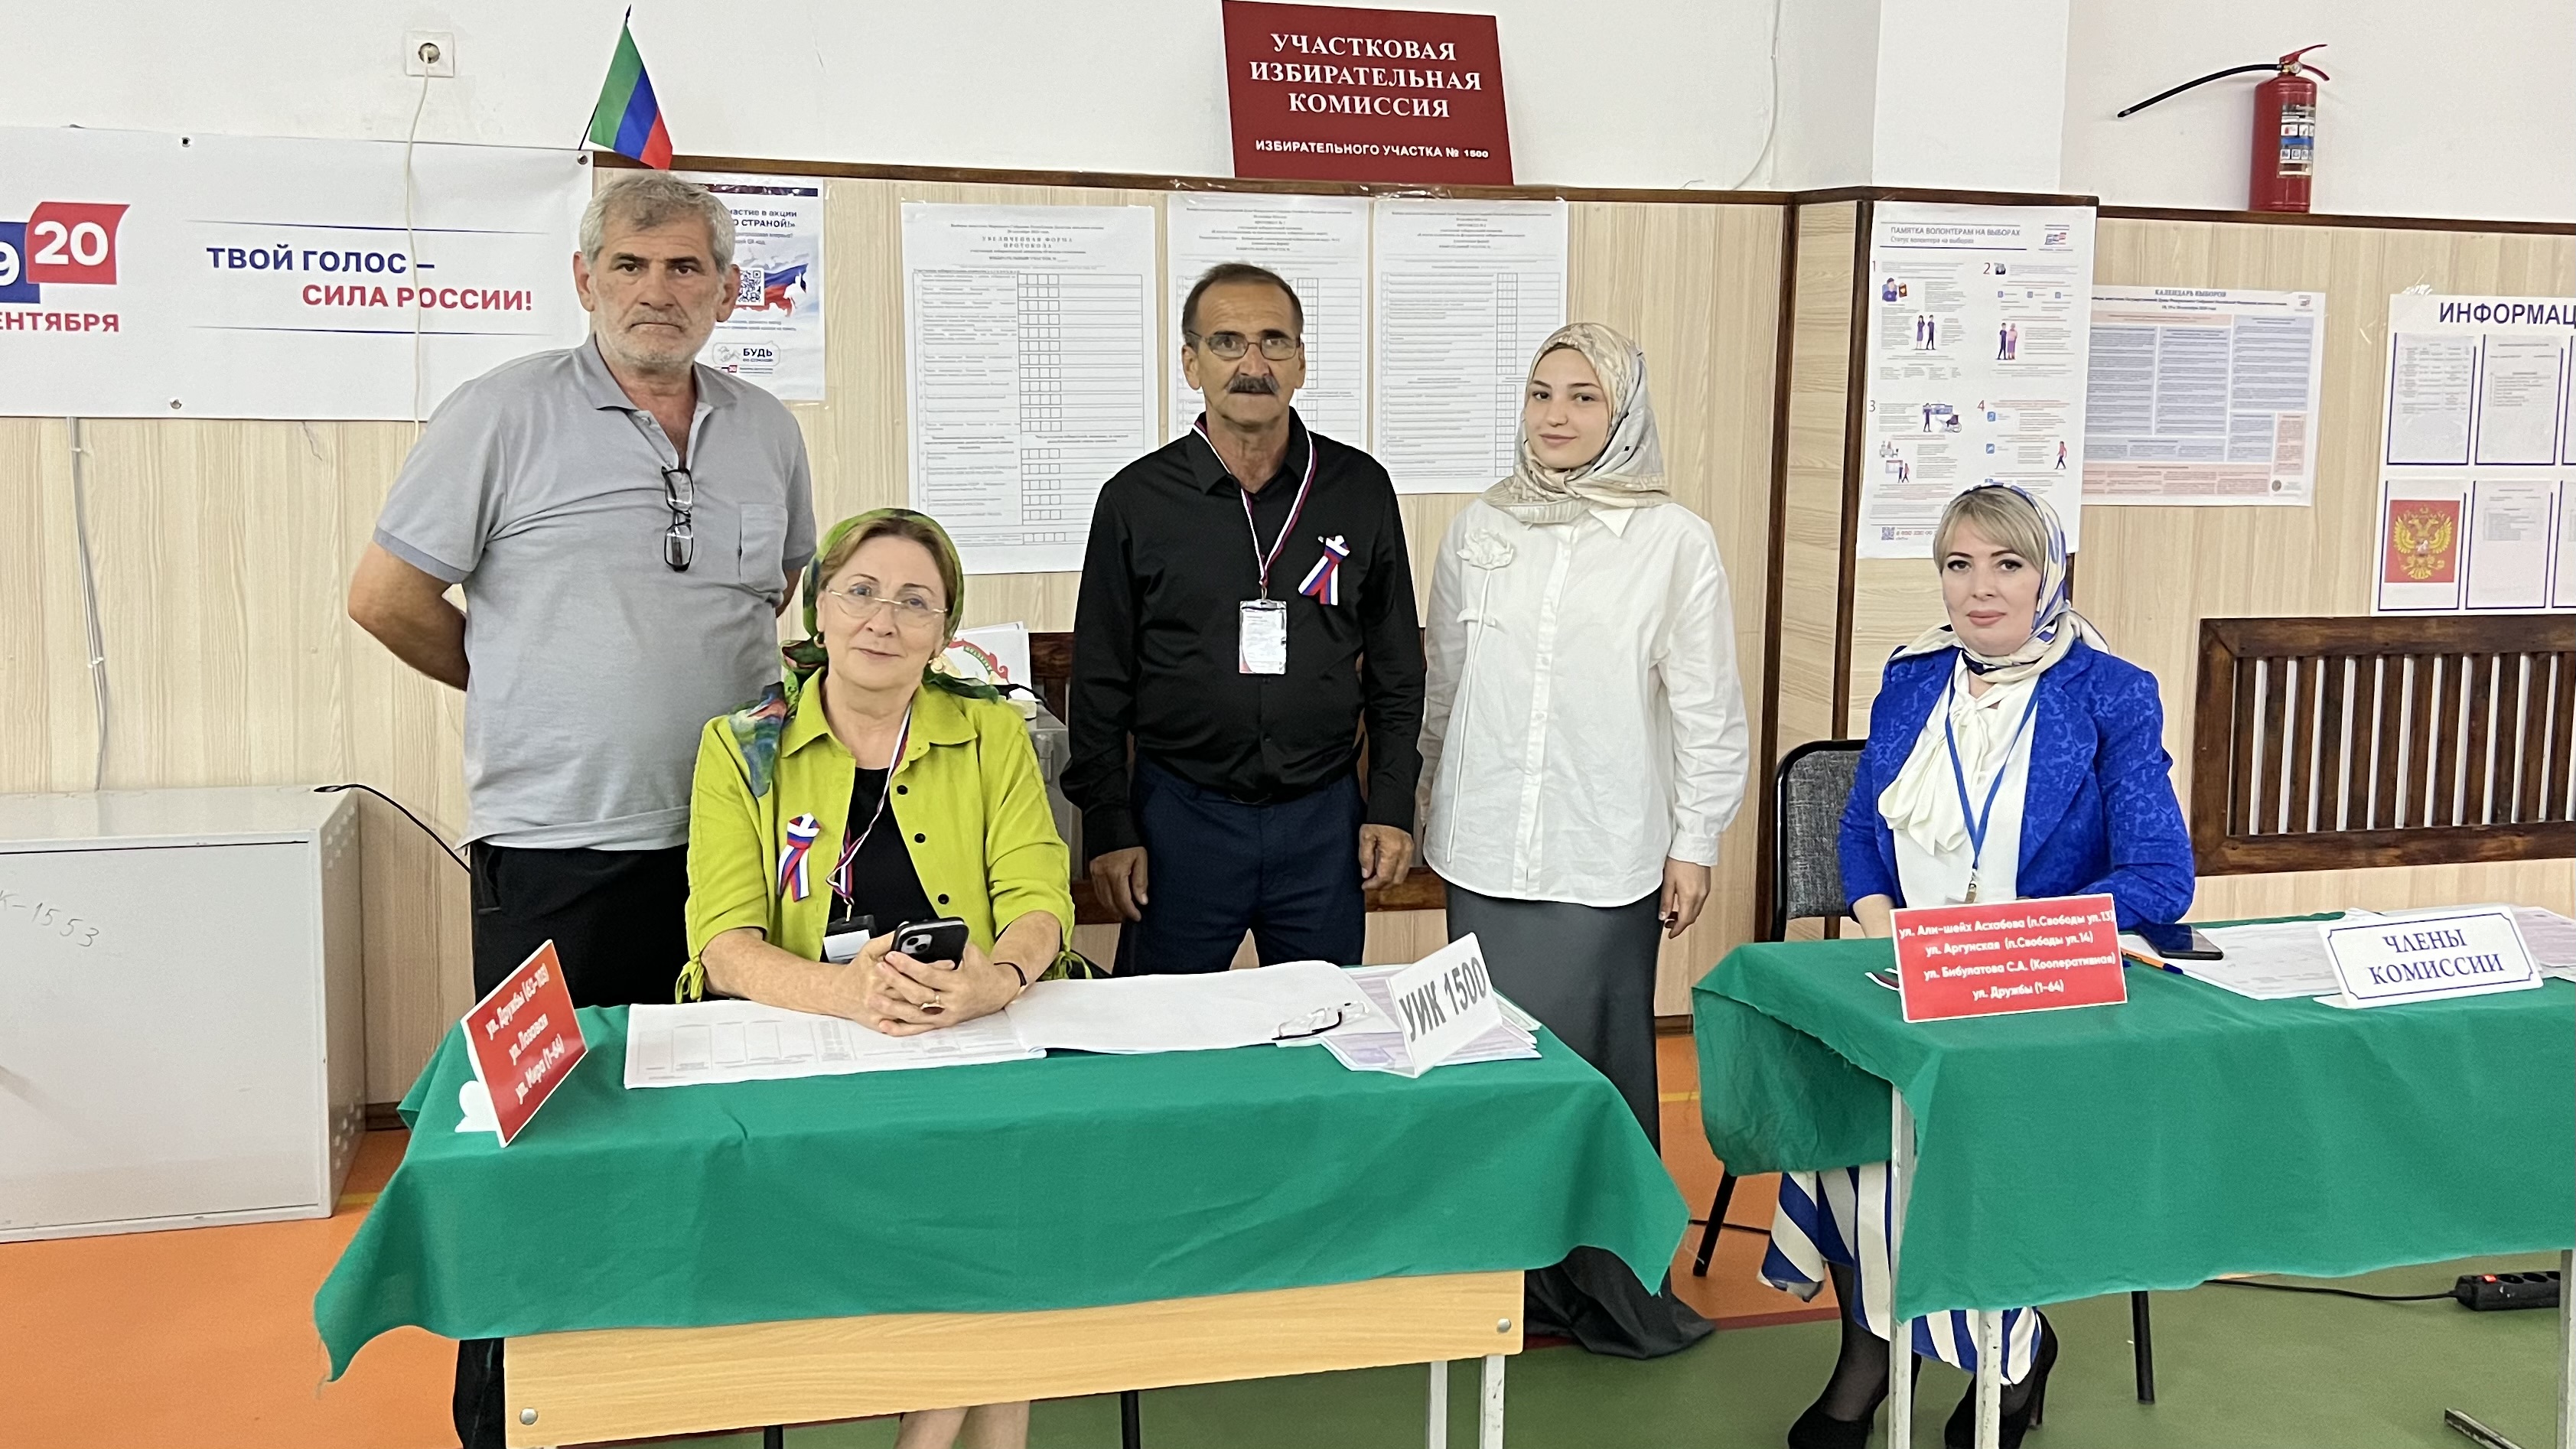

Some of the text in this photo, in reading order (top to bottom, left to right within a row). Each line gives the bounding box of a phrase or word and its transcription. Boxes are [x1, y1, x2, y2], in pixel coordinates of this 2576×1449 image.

[1270, 33, 1457, 61] УЧАСТКОВАЯ
[1249, 61, 1482, 90] ИЗБИРАТЕЛЬНАЯ
[1288, 93, 1451, 118] КОМИССИЯ
[1255, 139, 1489, 158] ИЗБИРАТЕЛЬНОГО УЧАСТКА № 1500
[34, 220, 109, 266] 20
[1926, 227, 1974, 236] ВОЛОНТЕРАМ
[207, 244, 293, 271] ТВОЙ
[303, 250, 407, 275] ГОЛОС
[1983, 262, 1991, 275] 2
[302, 284, 533, 311] СИЛА РОССИИ!
[0, 311, 119, 333] НТЯБРЯ
[2439, 302, 2576, 329] ИНФОРМАЦ
[743, 348, 773, 357] БУДЬ
[1868, 399, 1876, 412] 3
[1977, 399, 1985, 412] 4
[1898, 928, 1916, 939] ул.
[1917, 921, 1972, 936] Али-шейх
[1975, 918, 2025, 932] Асхабова
[2382, 928, 2468, 953] ЧЛЕНЫ
[1925, 946, 1943, 958] ул.
[1944, 941, 2001, 956] Аргунская
[1923, 952, 2116, 982] ул. Бибулатова С.А. (Кооперативная)
[2367, 953, 2506, 985] КОМИССИИ
[1399, 956, 1487, 1043] УИК 1500
[1972, 979, 2064, 1001] ул. Дружбы (1-64)
